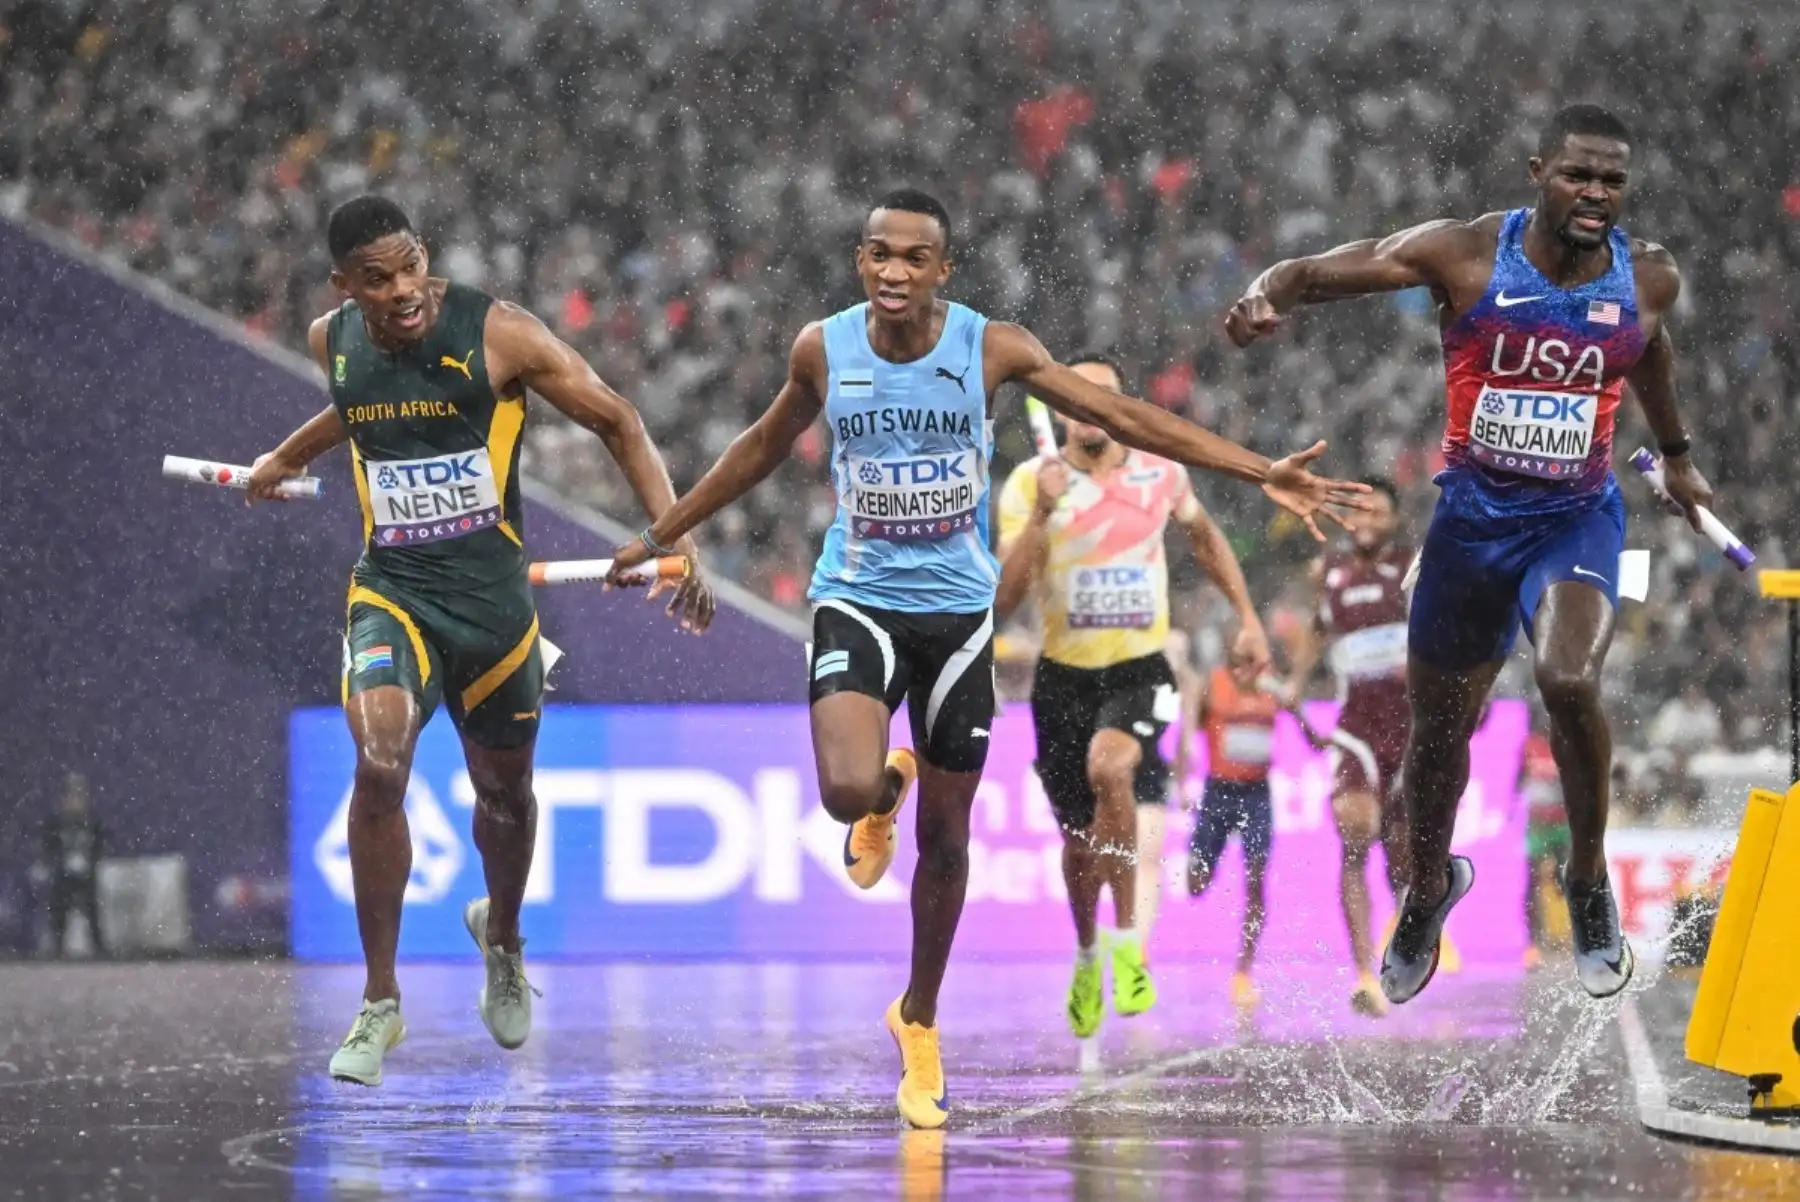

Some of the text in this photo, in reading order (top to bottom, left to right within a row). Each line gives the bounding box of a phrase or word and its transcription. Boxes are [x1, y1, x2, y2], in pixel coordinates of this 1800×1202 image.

[1491, 332, 1605, 390] USA
[347, 401, 459, 424] SOUTH AFRICA
[838, 407, 972, 442] BOTSWANA
[1506, 393, 1588, 423] TDK
[1474, 416, 1587, 456] BENJAMIN
[397, 453, 482, 488] TDK
[881, 455, 967, 486] TDK
[387, 484, 480, 521] NENE
[855, 482, 973, 517] KEBINATSHIPI
[1096, 567, 1149, 585] TDK
[450, 767, 905, 903] TDK
